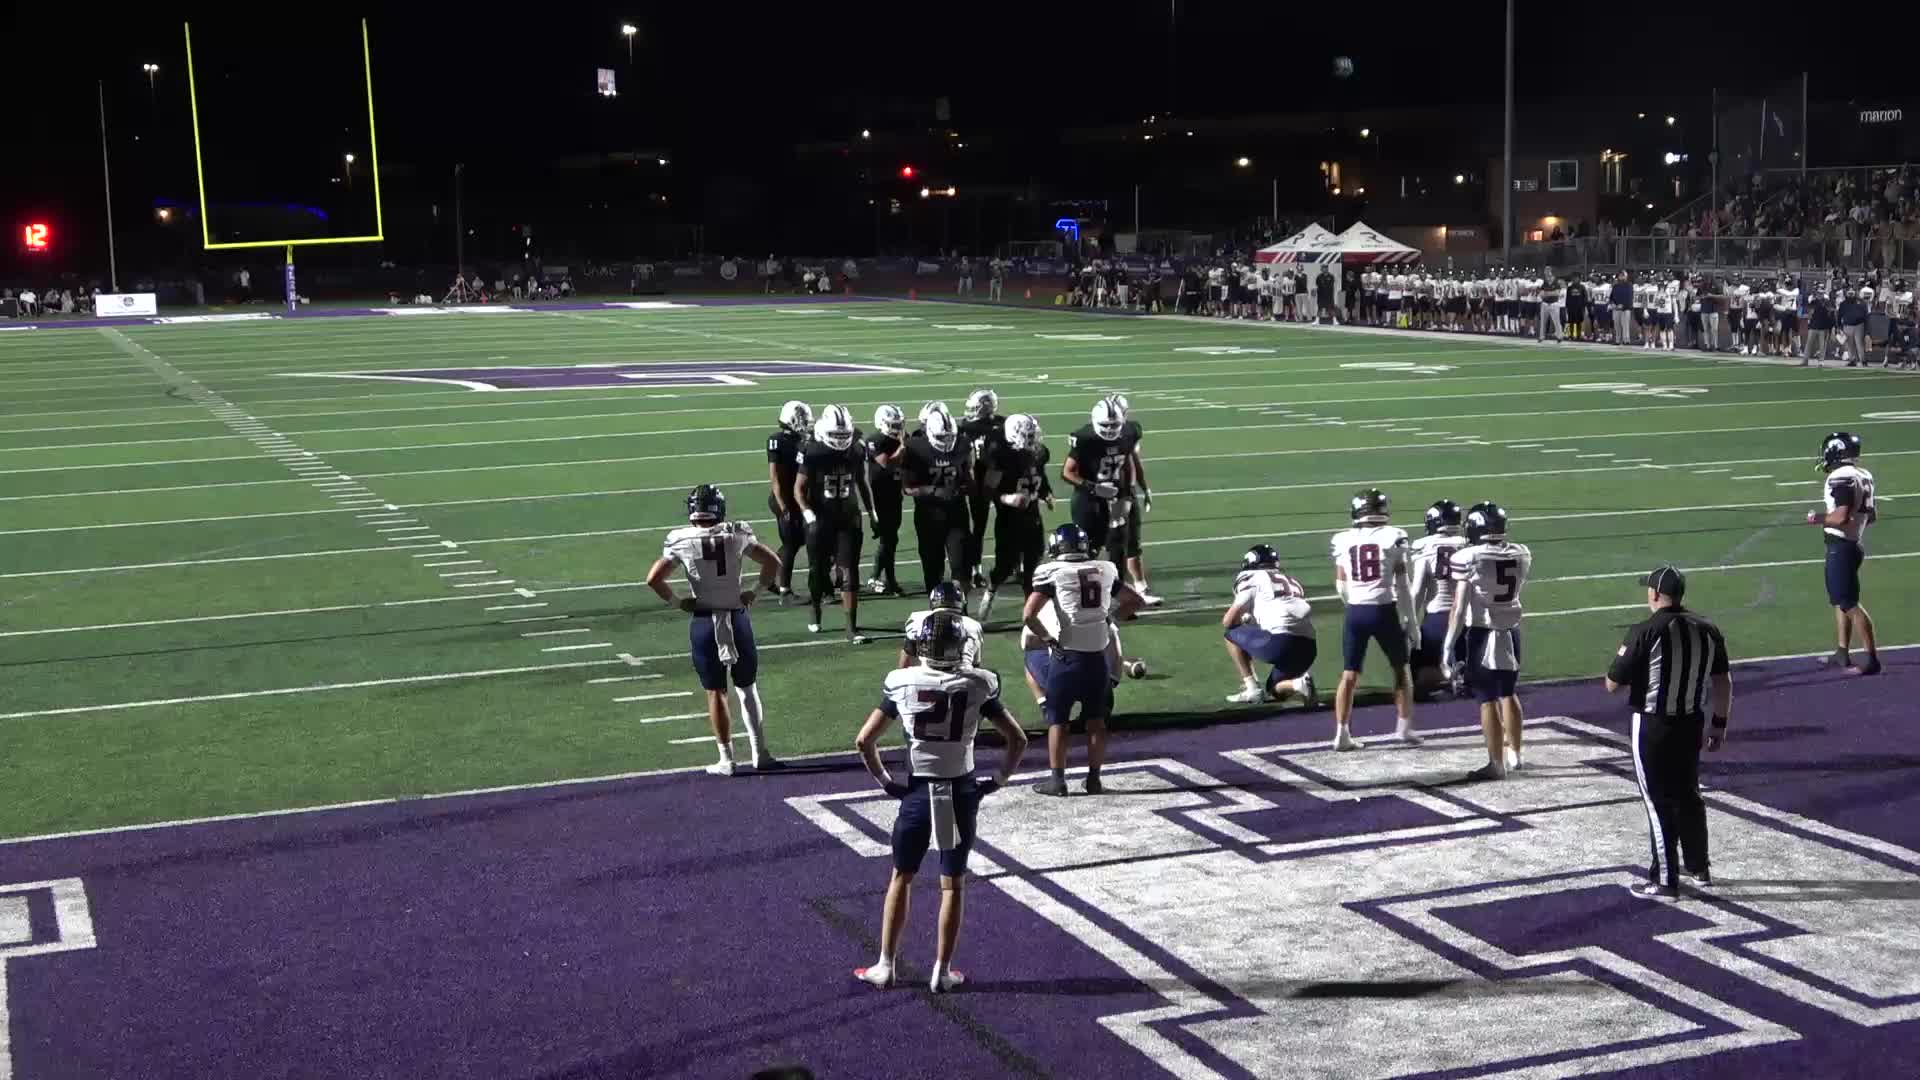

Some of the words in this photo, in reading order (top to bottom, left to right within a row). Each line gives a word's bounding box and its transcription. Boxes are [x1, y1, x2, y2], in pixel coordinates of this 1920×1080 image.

[26, 223, 47, 247] 12
[823, 473, 852, 499] 55
[702, 536, 727, 577] 4
[1350, 543, 1380, 582] 18
[1077, 567, 1101, 609] 6
[1494, 559, 1517, 601] 5
[913, 690, 968, 742] 21
